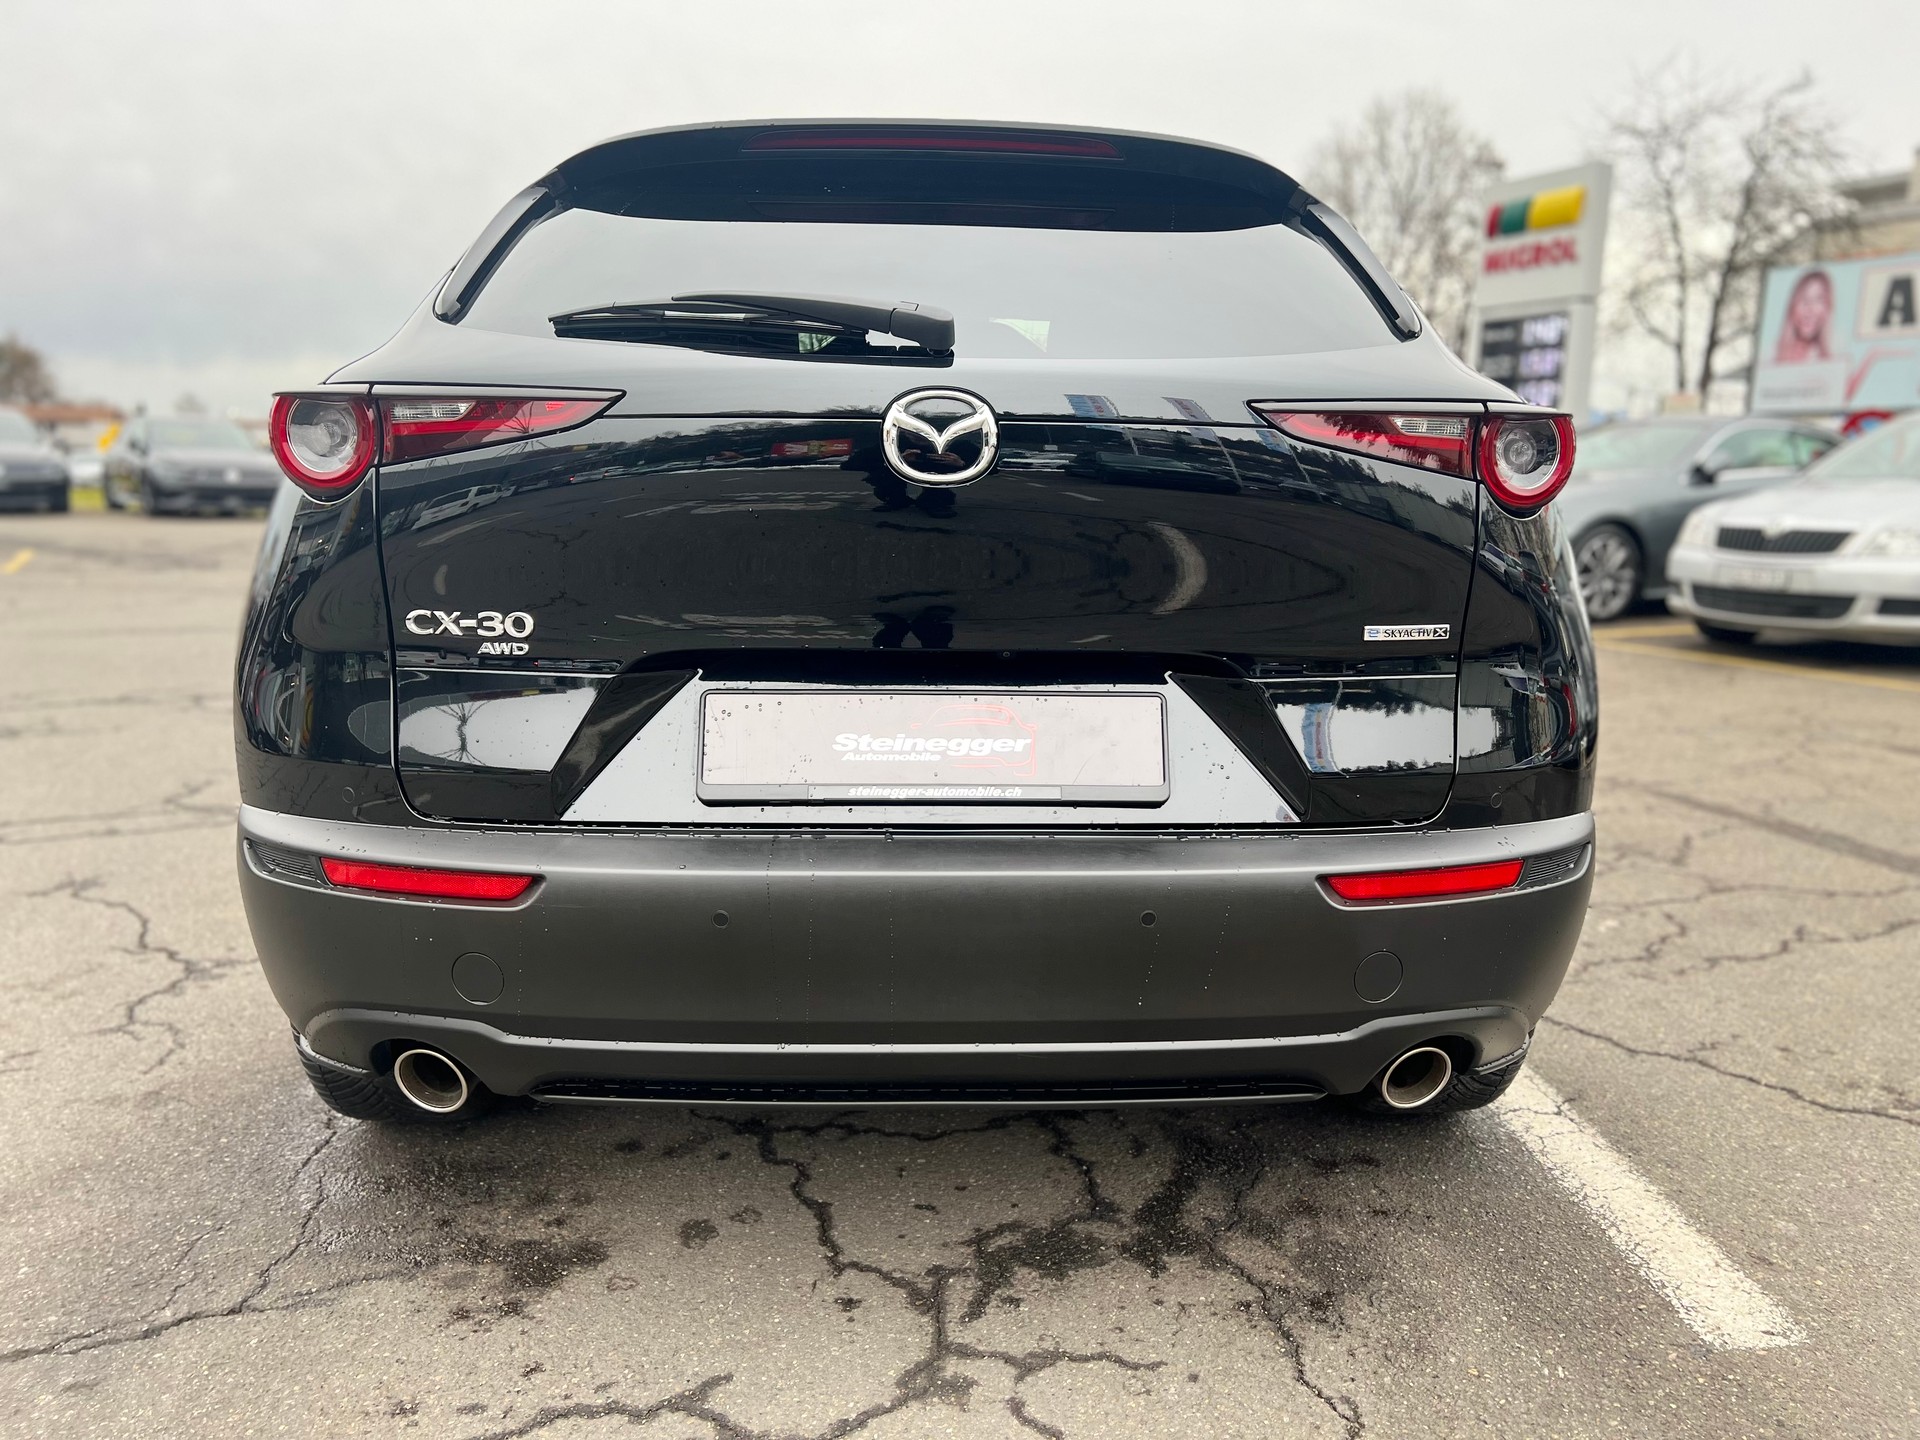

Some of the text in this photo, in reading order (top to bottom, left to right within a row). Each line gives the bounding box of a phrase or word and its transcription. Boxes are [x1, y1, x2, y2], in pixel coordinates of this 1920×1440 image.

[1876, 276, 1917, 327] A
[405, 609, 534, 638] CX-30
[477, 642, 530, 655] AWD
[832, 733, 1031, 756] Steinegger
[841, 752, 942, 762] Automobile
[848, 786, 1022, 798] steinegger-automobile.ch
